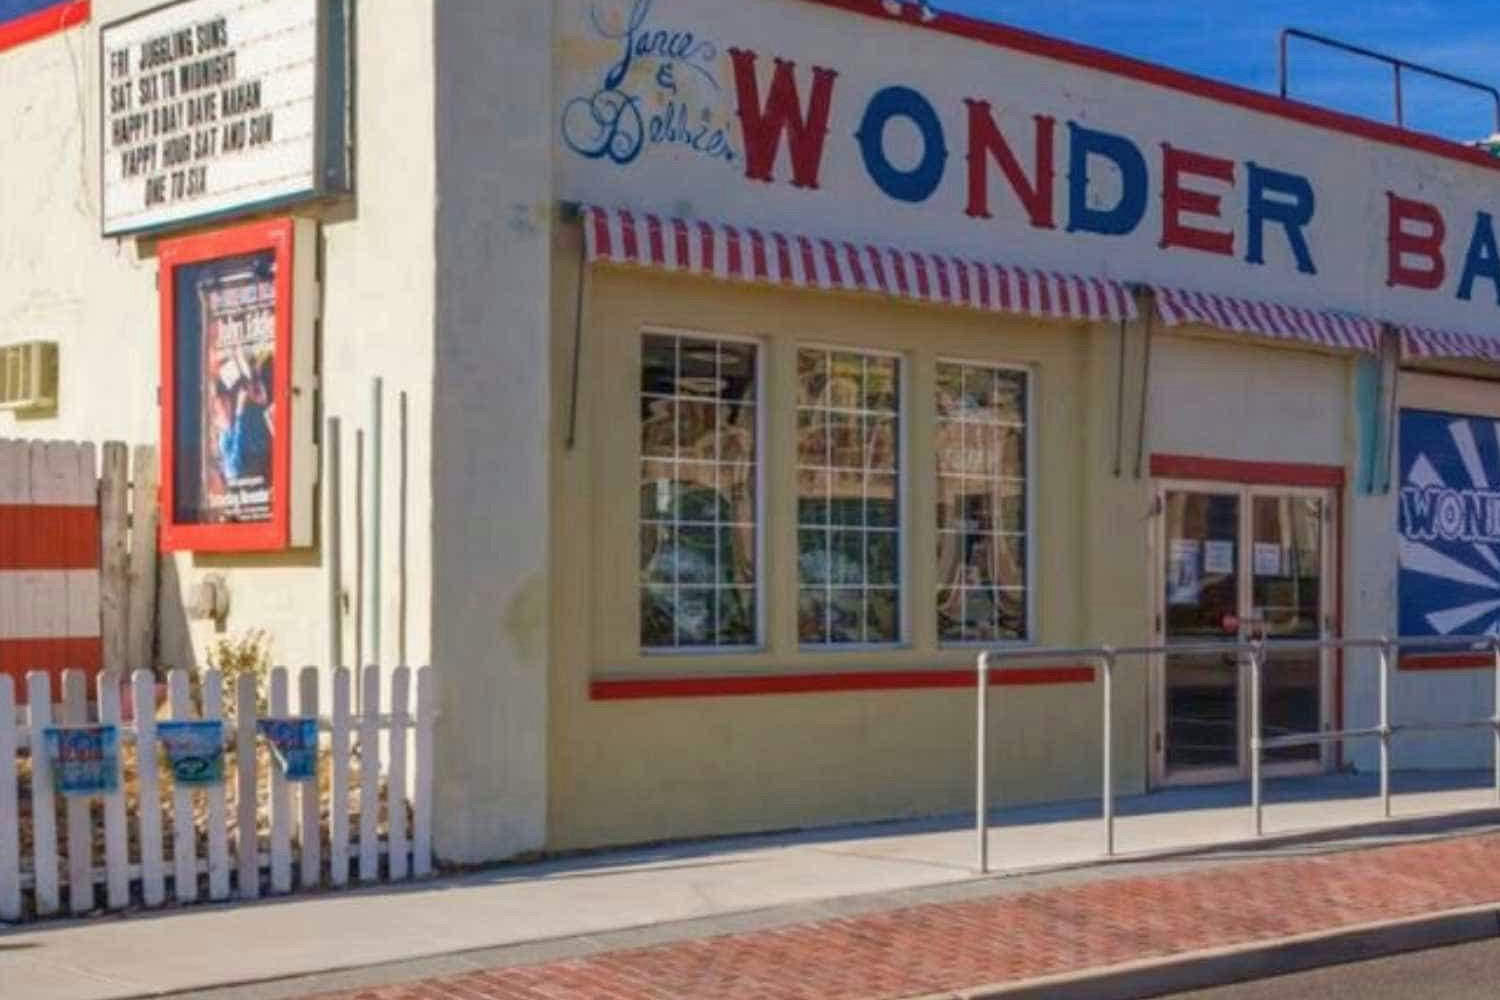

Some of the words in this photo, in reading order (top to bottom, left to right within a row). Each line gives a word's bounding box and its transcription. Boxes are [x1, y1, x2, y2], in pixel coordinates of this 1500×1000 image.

[110, 47, 129, 79] FRI
[110, 81, 132, 113] SAT
[160, 68, 176, 99] TO
[180, 50, 237, 95] MIDNIGHT
[111, 110, 150, 147] HAPPY
[194, 127, 218, 160] SAT
[221, 120, 247, 152] AND
[249, 112, 274, 147] SUN
[170, 169, 186, 199] TO
[187, 164, 208, 196] SIX
[727, 45, 1318, 276] WONDER
